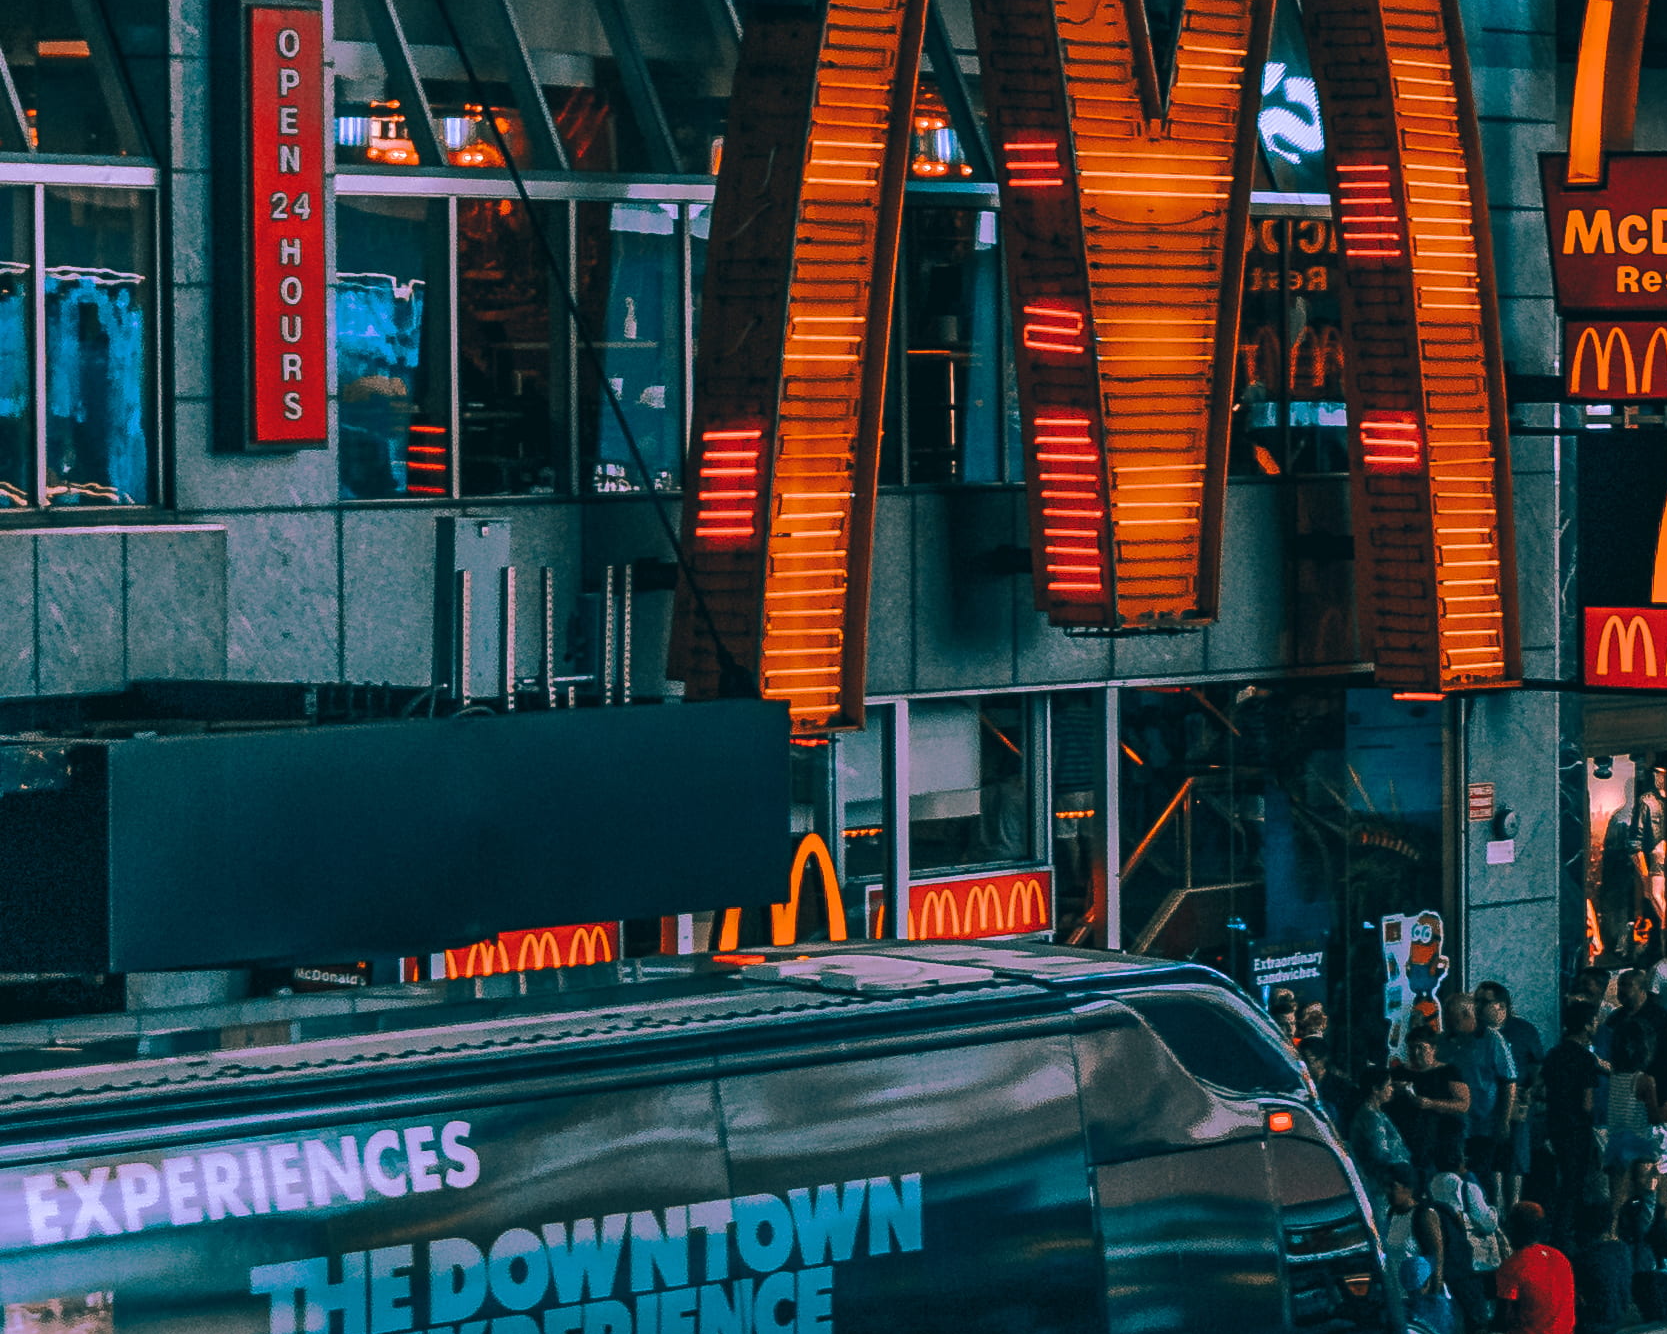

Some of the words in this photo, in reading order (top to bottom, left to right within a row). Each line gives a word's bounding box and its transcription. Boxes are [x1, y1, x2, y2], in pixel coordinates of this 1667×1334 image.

[277, 28, 302, 176] OPEN
[270, 191, 311, 221] 24
[278, 236, 304, 421] HOURS
[1253, 951, 1323, 972] Extraordinary
[1256, 966, 1321, 986] sandwiches.
[23, 1120, 481, 1246] EXPERIENCES
[429, 1173, 924, 1328] DOWNTOWN
